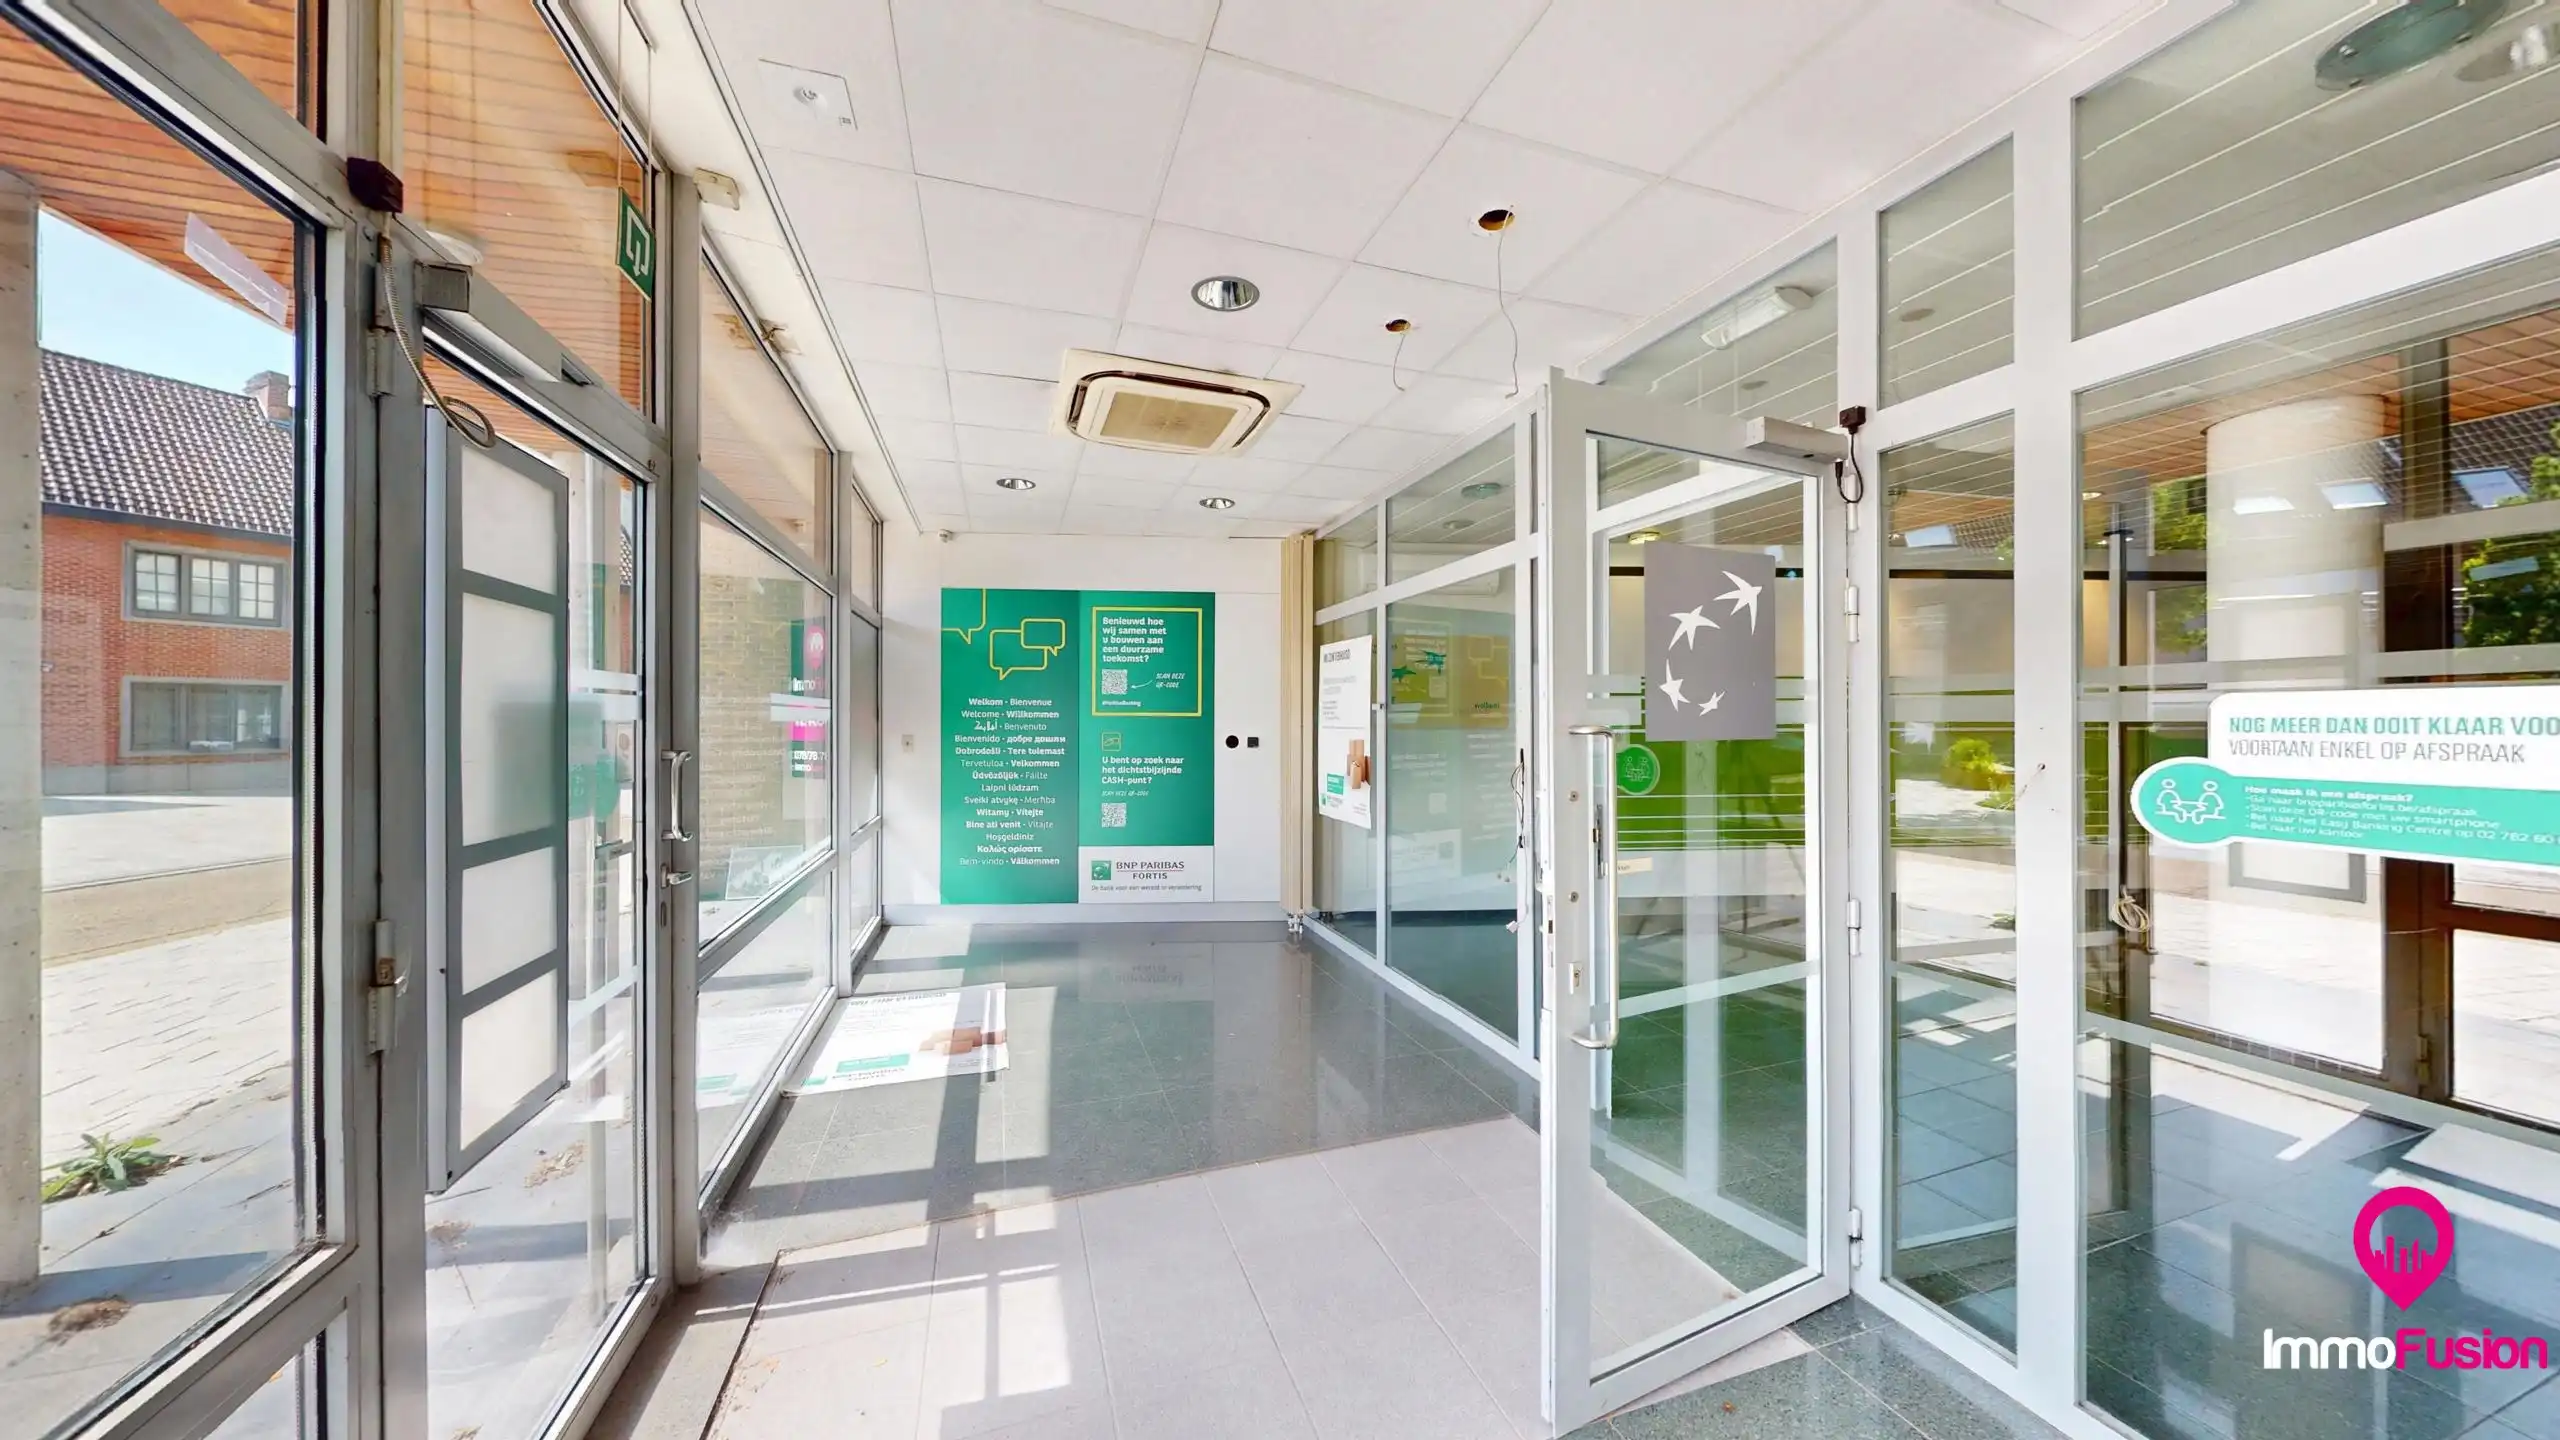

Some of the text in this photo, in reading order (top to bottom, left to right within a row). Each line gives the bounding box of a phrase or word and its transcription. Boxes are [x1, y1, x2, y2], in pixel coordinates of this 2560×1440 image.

[1102, 617, 1164, 625] Benieuwd hoe
[1102, 627, 1116, 636] wij
[1149, 627, 1167, 635] met
[1110, 636, 1145, 644] bouwen
[1120, 645, 1164, 653] duurzame
[1102, 655, 1149, 663] toekomst?
[968, 698, 1053, 706] Welkom Bienvenue
[961, 710, 1060, 718] Welcome Willkommen
[1004, 723, 1048, 731] Benvenuto
[2229, 717, 2265, 733] NOG
[2270, 717, 2321, 734] MEER
[2326, 717, 2368, 734] DAN
[2374, 717, 2423, 735] OOIT
[2428, 717, 2505, 735] KLAAR
[954, 735, 1001, 743] Bienvenido
[1007, 747, 1027, 755] Tere
[1028, 747, 1065, 755] tulemast
[2228, 739, 2525, 763] VOORTAAN ENKEL OP AFSPRAAK
[961, 759, 1060, 767] Tervetuloa Velkommen
[1110, 756, 1130, 764] bent
[1143, 756, 1164, 764] zoek
[1102, 766, 1182, 775] het dichtstbijzijnde
[1102, 777, 1152, 785] CASH-punt?
[981, 784, 1006, 792] Laipni
[976, 808, 1010, 817] Witamy
[2413, 816, 2501, 829] smartphone
[1116, 861, 1185, 869] BNP PARIBAS
[1132, 872, 1168, 880] FORTIS
